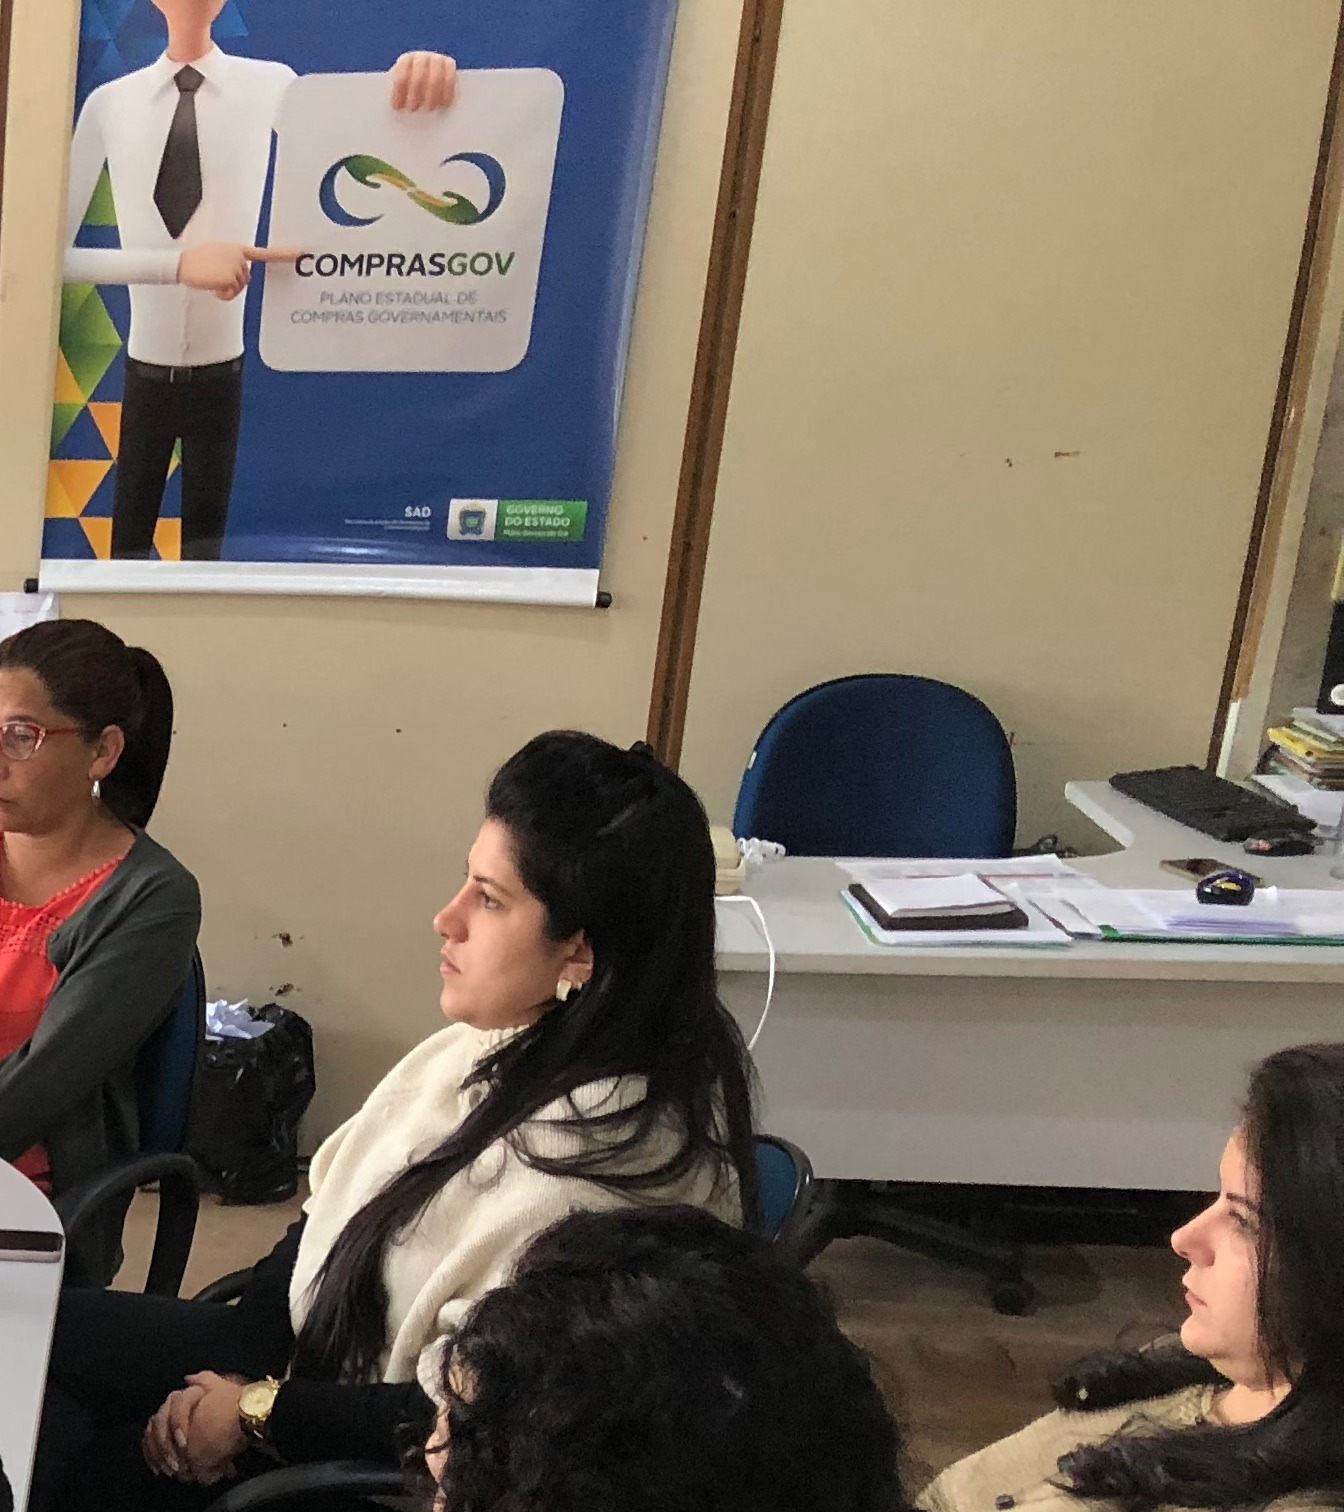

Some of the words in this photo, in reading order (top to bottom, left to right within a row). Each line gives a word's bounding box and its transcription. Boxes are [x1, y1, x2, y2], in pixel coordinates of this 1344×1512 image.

[295, 251, 516, 277] COMPRASGOV
[319, 290, 372, 306] PLANO
[374, 290, 450, 305] ESTADUAL
[456, 290, 477, 305] DE
[290, 310, 365, 325] COMPRAS
[367, 308, 509, 324] GOVERNAMENTAIS
[404, 506, 431, 518] SAD
[506, 504, 564, 515] GOVERNO
[504, 517, 523, 526] DO
[524, 516, 571, 527] ESTADO
